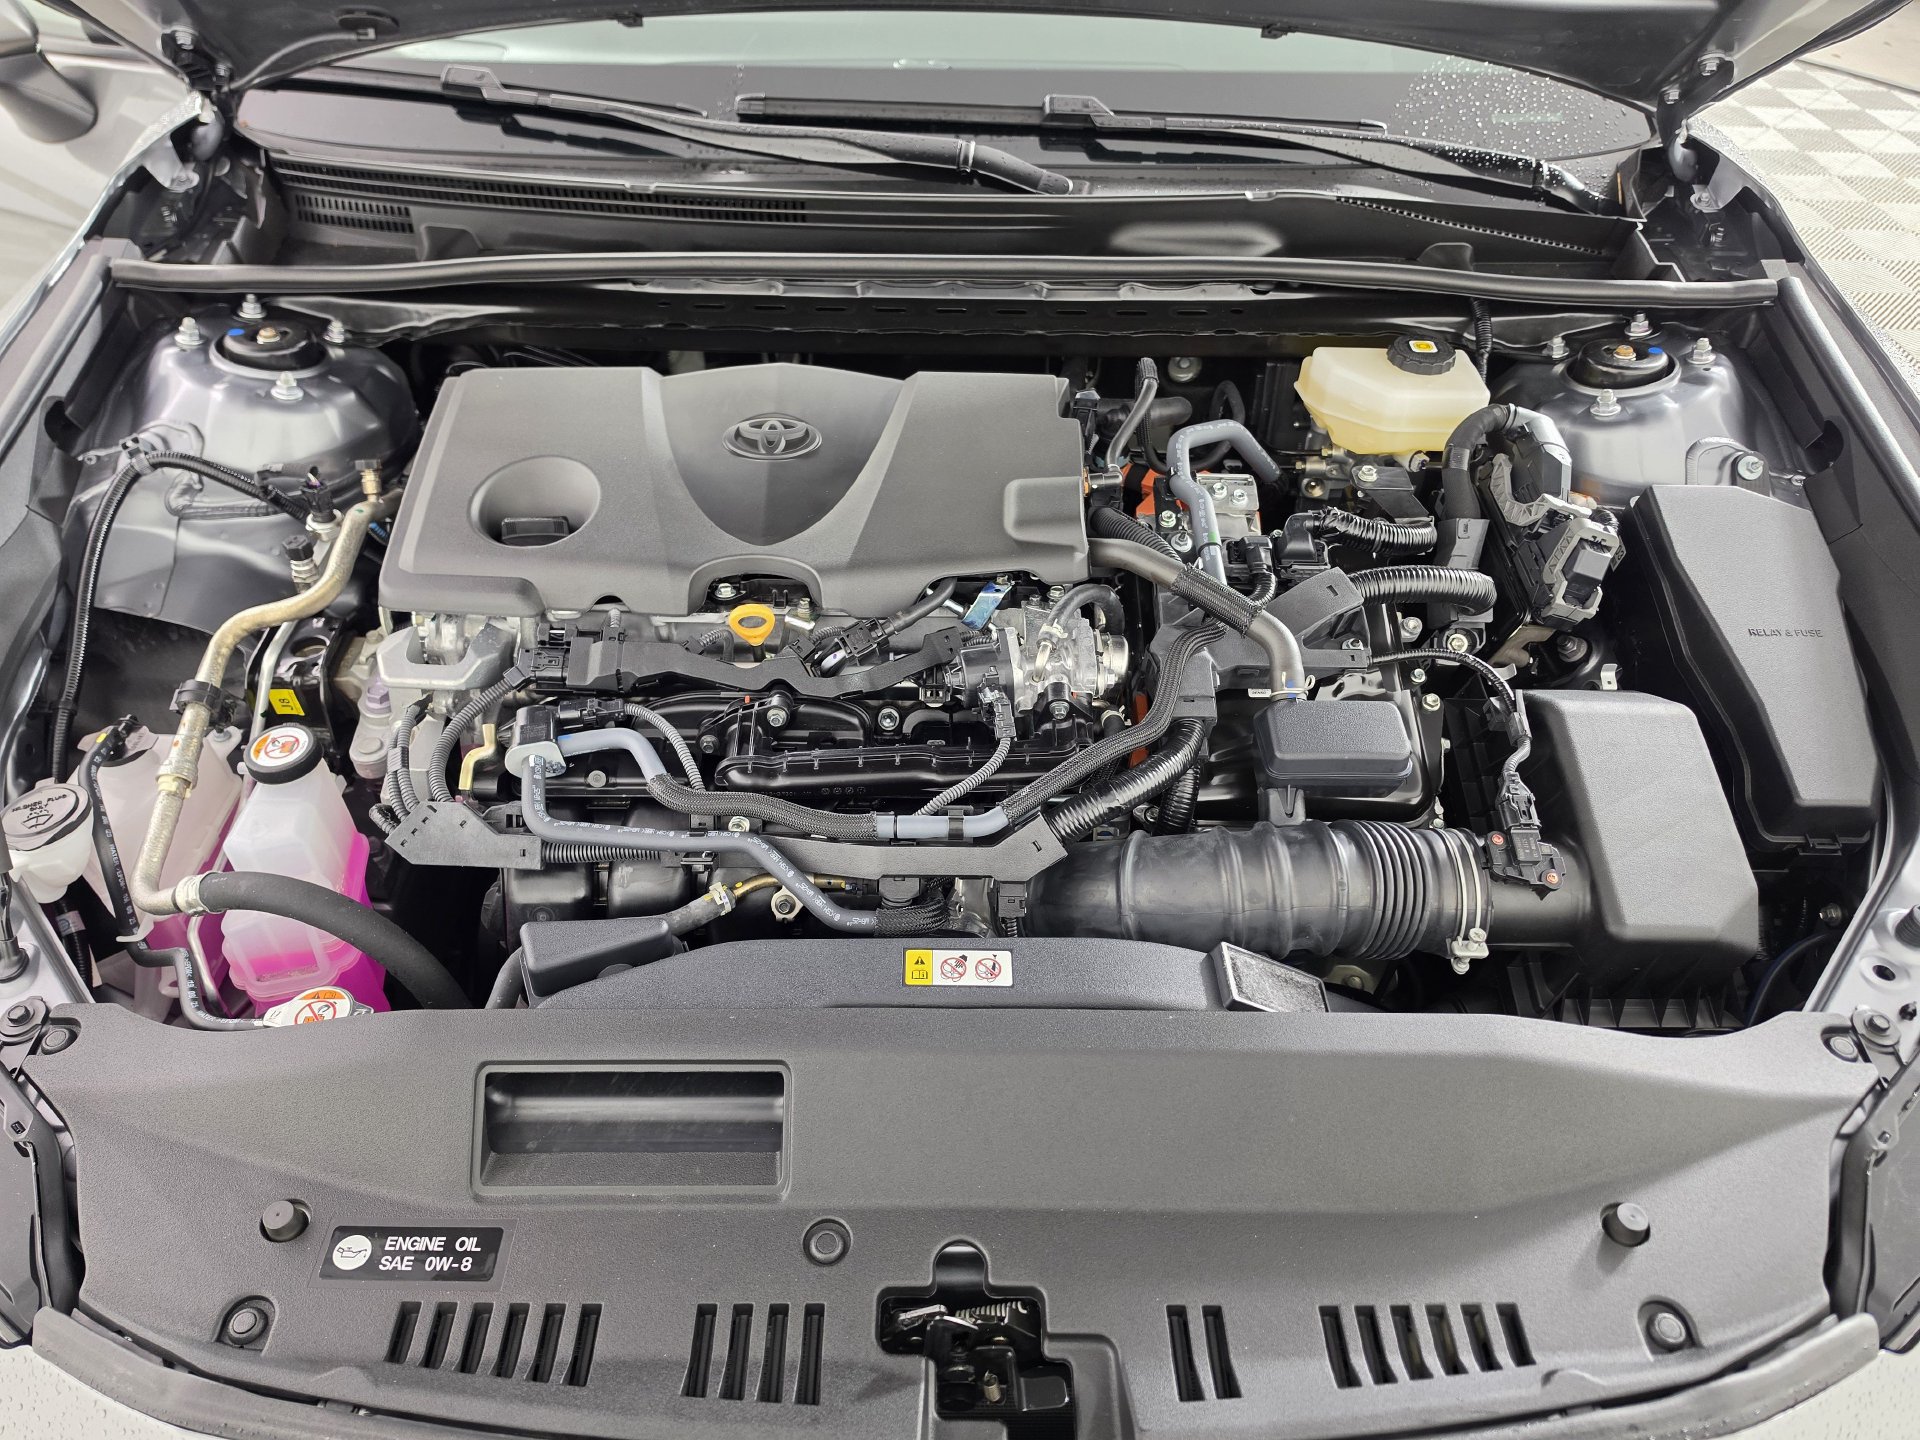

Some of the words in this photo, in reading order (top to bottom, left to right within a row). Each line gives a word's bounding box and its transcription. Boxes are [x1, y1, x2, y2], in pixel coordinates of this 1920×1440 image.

[1747, 628, 1782, 637] RELAY
[1785, 629, 1793, 637] &
[1794, 629, 1823, 638] FUSE
[384, 1236, 446, 1252] ENGINE
[455, 1236, 482, 1252] OIL
[378, 1255, 415, 1271] SAE
[424, 1256, 472, 1272] 0W-8
